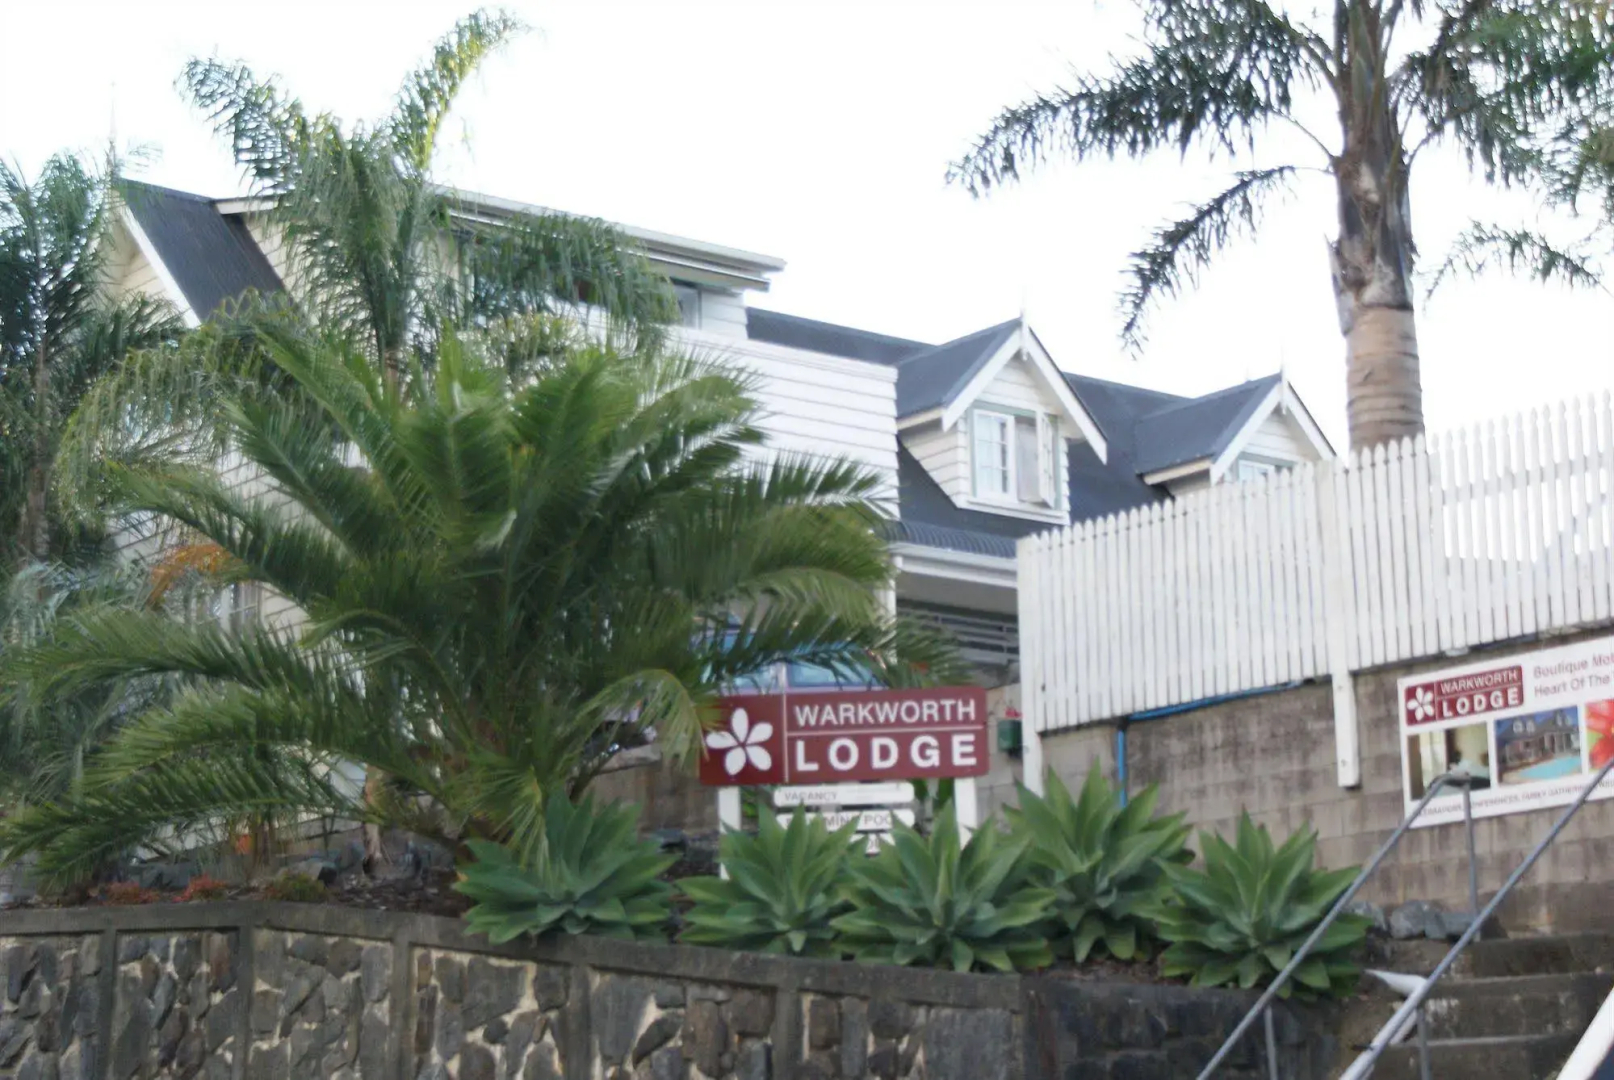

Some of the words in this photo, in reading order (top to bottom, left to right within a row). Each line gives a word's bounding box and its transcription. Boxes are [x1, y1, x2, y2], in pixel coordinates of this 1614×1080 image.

[1440, 668, 1518, 694] WARKWORTH
[1533, 659, 1588, 678] Boutique
[1534, 680, 1567, 697] Heart
[1570, 676, 1585, 691] Of
[1587, 673, 1611, 688] The
[794, 699, 976, 726] WARKWORTH
[1442, 686, 1519, 717] LODGE
[796, 734, 977, 771] LODGE
[784, 791, 838, 802] VACANCY
[864, 813, 893, 825] POO
